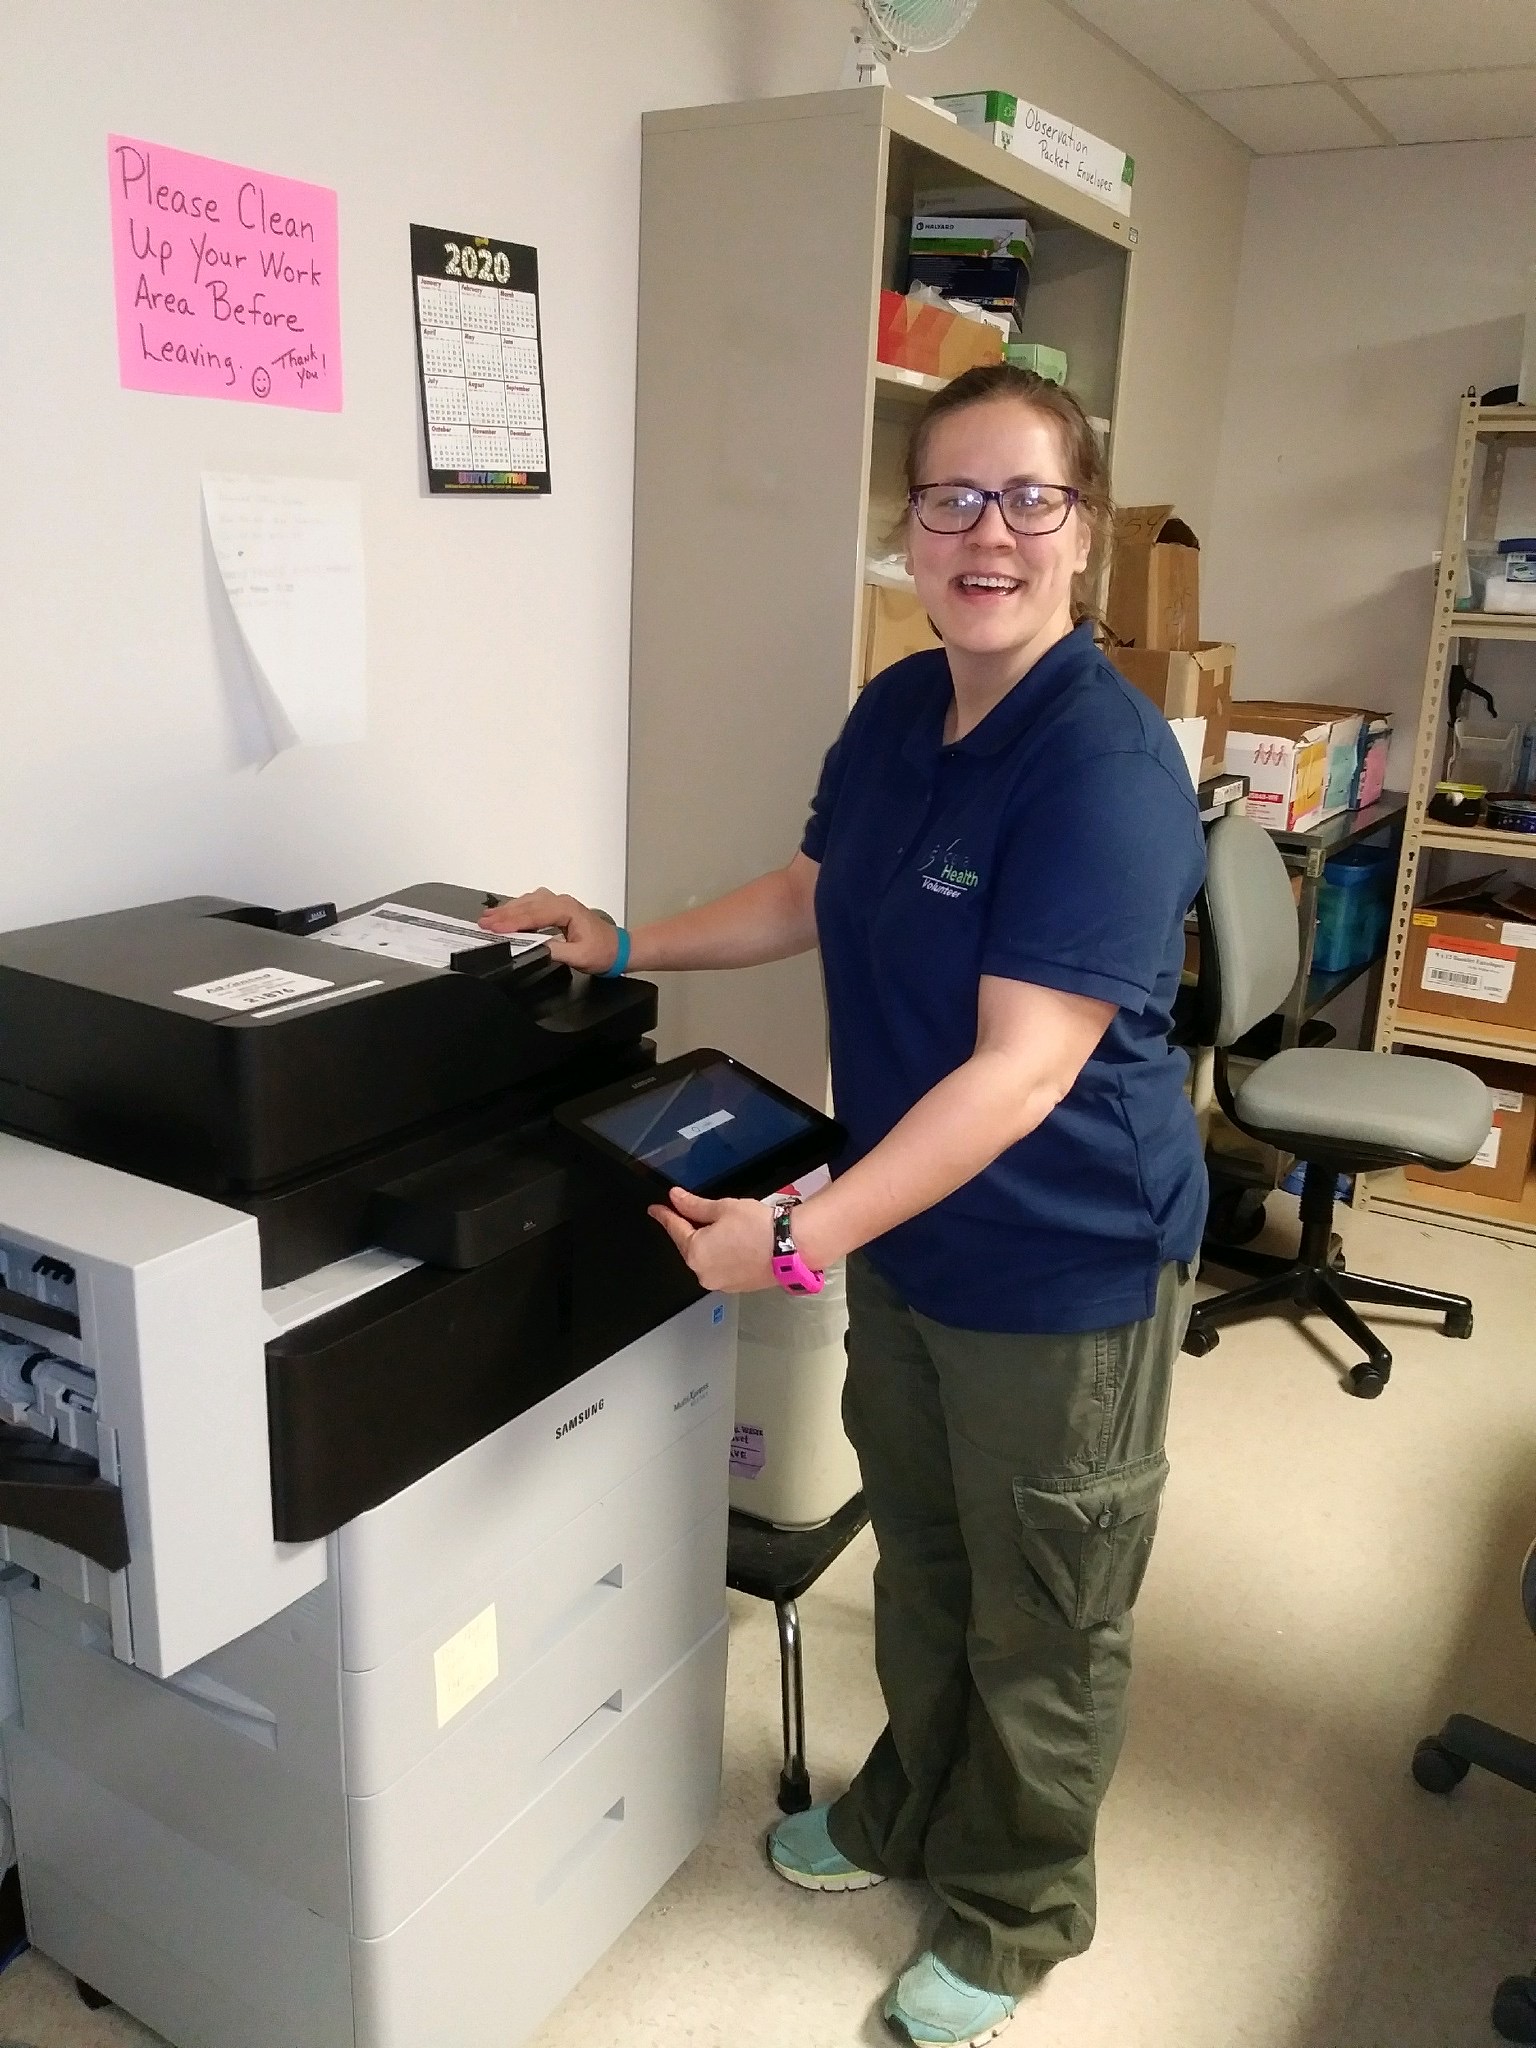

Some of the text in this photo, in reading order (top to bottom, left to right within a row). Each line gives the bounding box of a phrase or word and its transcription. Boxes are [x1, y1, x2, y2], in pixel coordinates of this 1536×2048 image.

[1025, 107, 1088, 155] Observation
[1038, 139, 1069, 170] Packet
[1076, 161, 1113, 192] Envelopes
[115, 145, 314, 242] Please Clean
[129, 217, 173, 275] Up
[259, 250, 322, 286] Work
[444, 242, 511, 284] 2020
[420, 278, 442, 288] January
[461, 285, 483, 295] February
[134, 272, 305, 332] Area Before
[500, 290, 515, 298] March
[423, 328, 437, 336] April
[464, 333, 475, 341] May
[271, 343, 318, 369] Thank
[427, 377, 439, 386] July
[468, 381, 485, 389] August
[506, 384, 530, 392] September
[472, 427, 497, 435] November
[940, 864, 979, 887] Health
[922, 878, 962, 898] Volunteer
[555, 1398, 605, 1440] SAMSUNG
